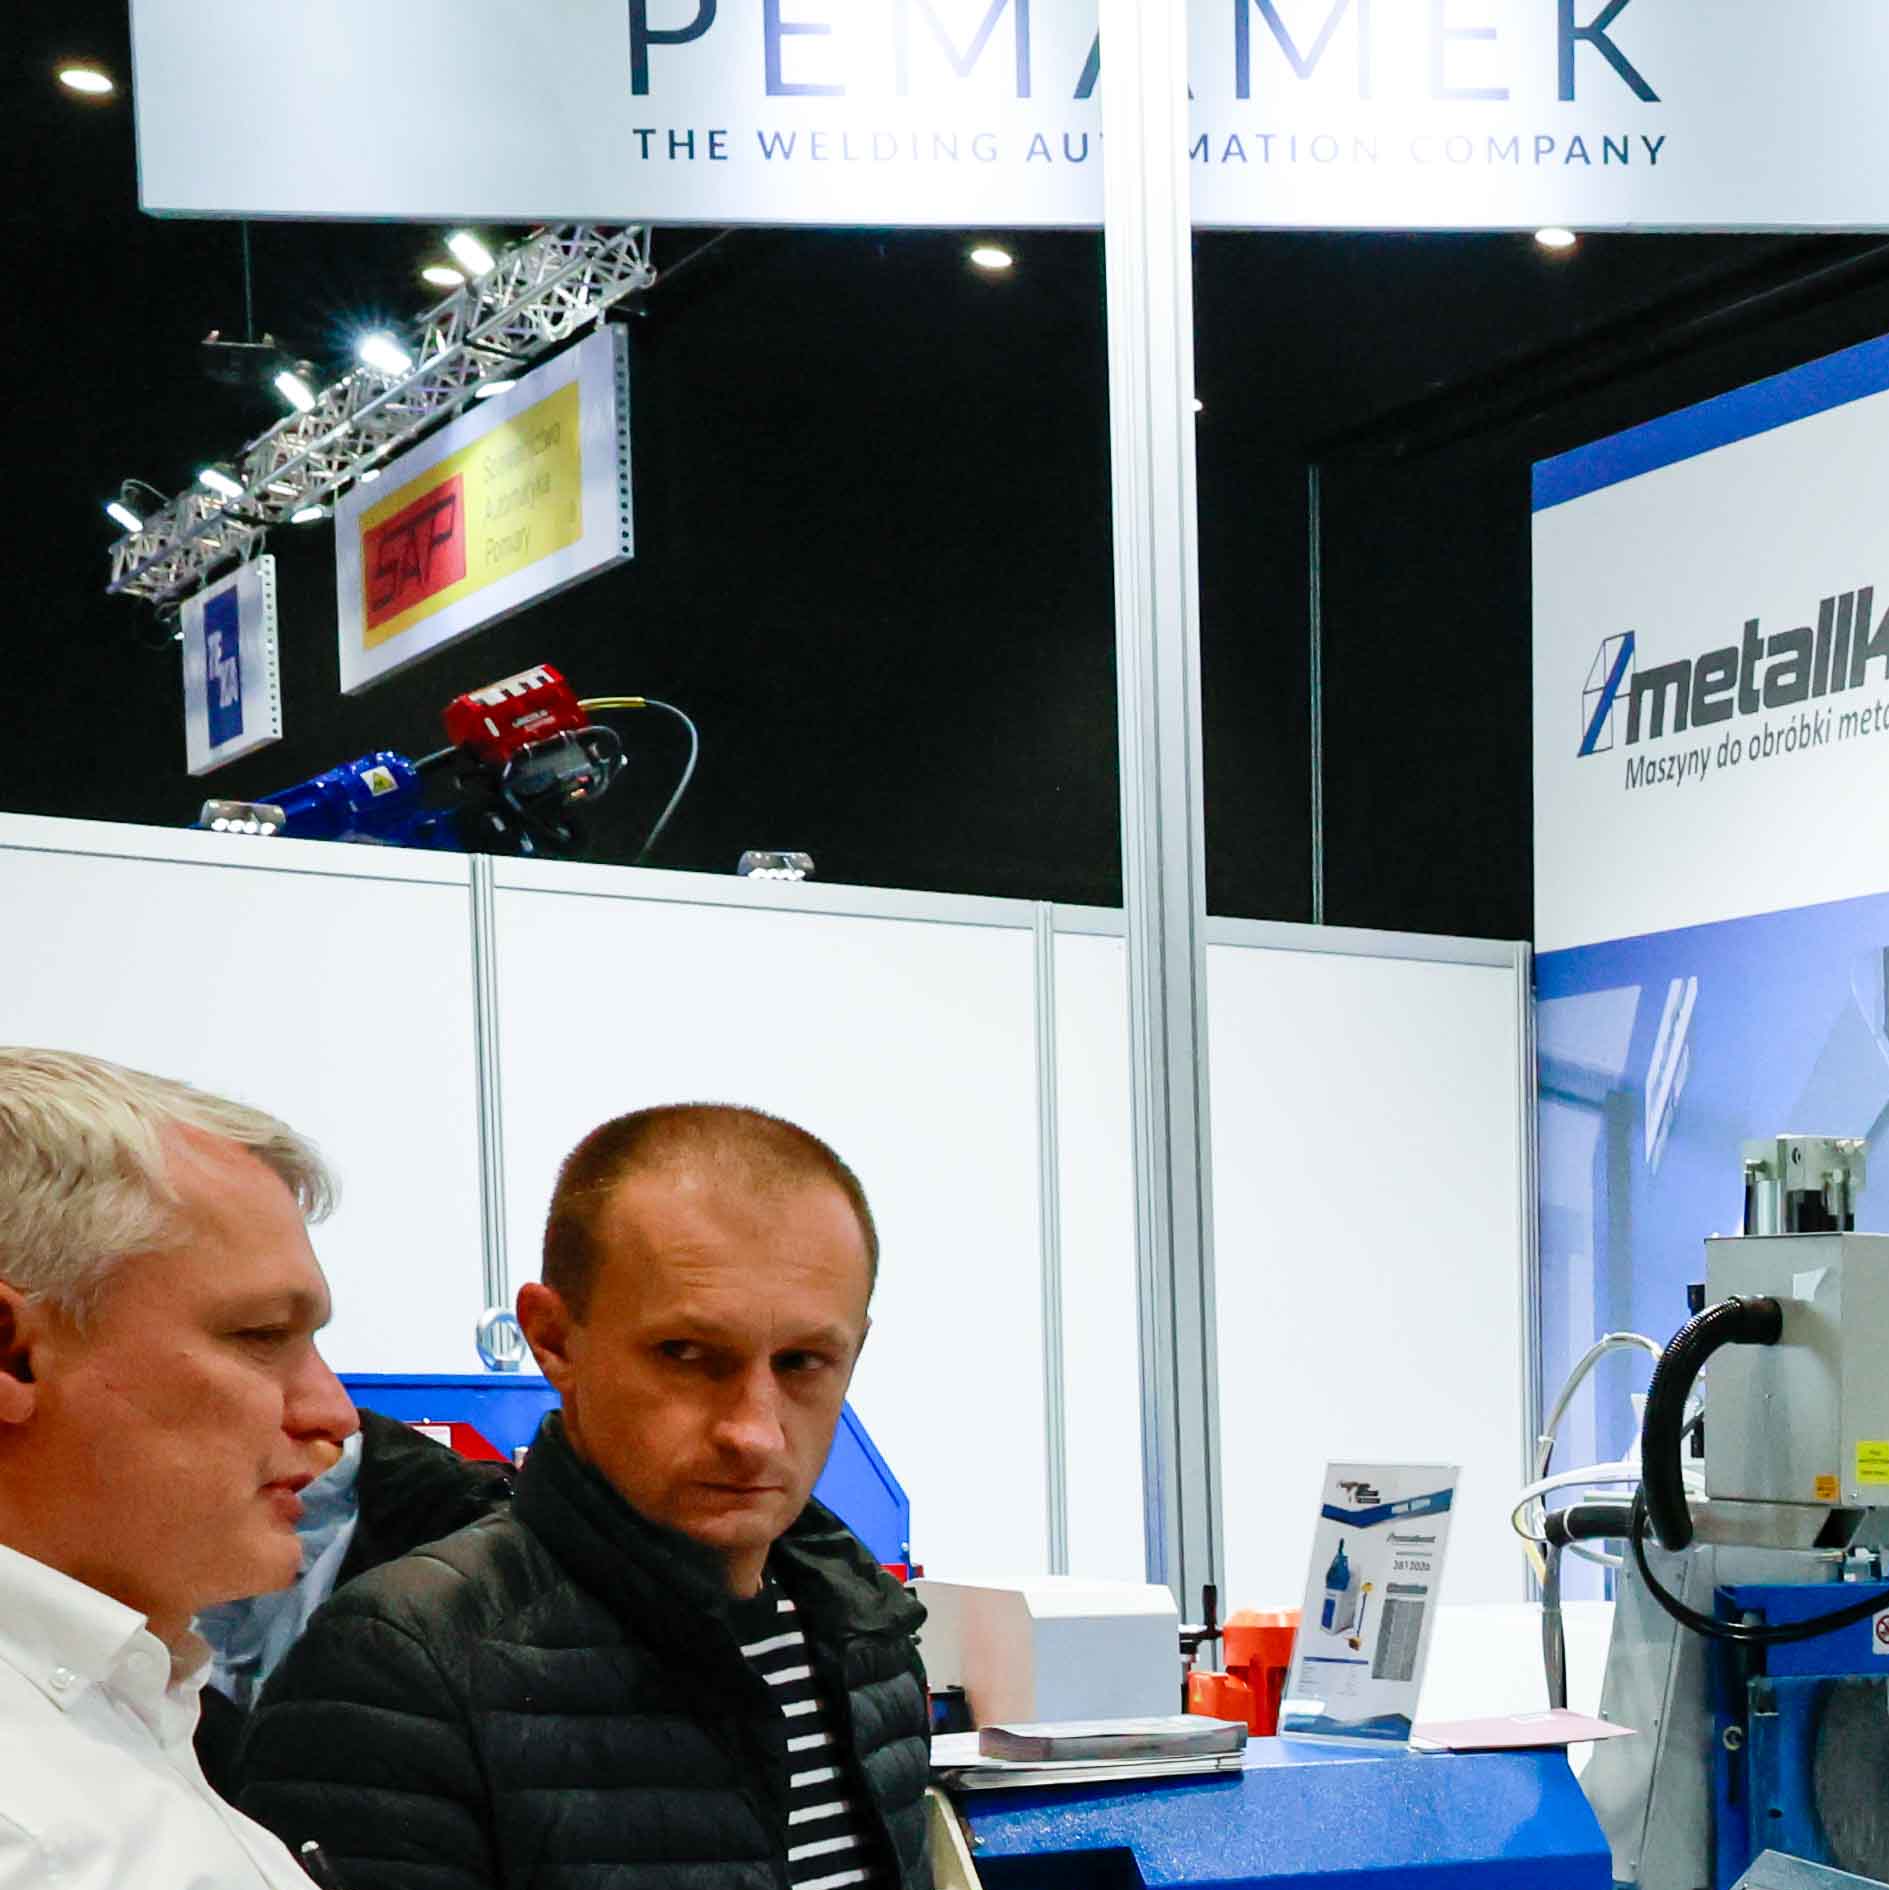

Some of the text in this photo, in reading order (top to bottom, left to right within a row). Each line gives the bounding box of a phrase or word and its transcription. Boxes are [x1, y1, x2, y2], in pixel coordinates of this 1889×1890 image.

[629, 0, 1661, 102] PEMMEK
[632, 128, 1668, 166] THE WELDING AUMATION COMPANY
[1624, 747, 1709, 791] Maszyny
[1717, 733, 1743, 768] do
[1747, 715, 1831, 765] obróbki
